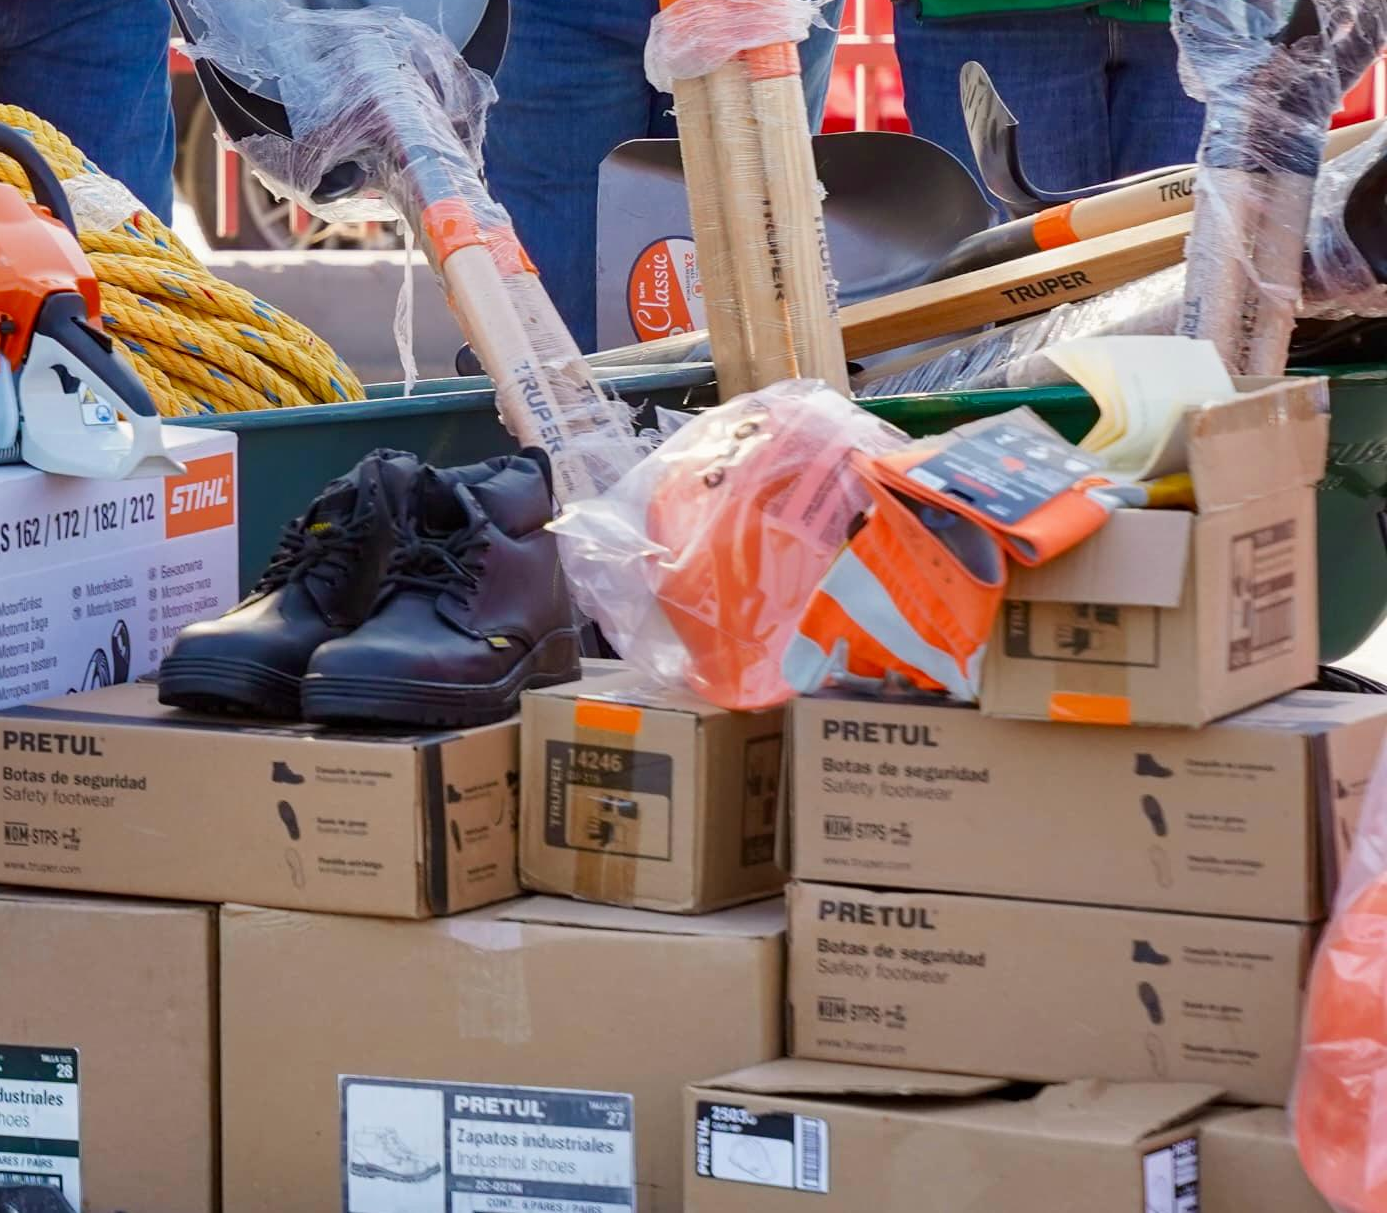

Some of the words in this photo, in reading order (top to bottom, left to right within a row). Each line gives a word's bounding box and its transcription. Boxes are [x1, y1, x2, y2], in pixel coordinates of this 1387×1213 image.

[636, 253, 672, 332] Classic
[1001, 270, 1092, 305] TRUPER
[170, 478, 228, 514] STIHL
[15, 518, 40, 549] 162
[44, 514, 50, 546] /
[55, 510, 79, 541] 172
[83, 506, 89, 538] /
[93, 501, 118, 532] 182
[121, 498, 127, 530] /
[130, 493, 155, 524] 212
[3, 730, 103, 756] PRETUL
[822, 719, 938, 747] PRETUL
[567, 748, 623, 772] 14246
[822, 757, 872, 774] Botas
[878, 762, 898, 776] de
[905, 765, 989, 783] seguridad
[3, 766, 45, 783] Botas
[51, 770, 69, 784] de
[74, 773, 146, 790] seguridad
[822, 777, 874, 798] Safety
[880, 782, 953, 800] footwear
[3, 786, 48, 806] Safety
[53, 790, 115, 807] footwear
[550, 757, 563, 827] TRUPER
[819, 900, 937, 929] PRETUL
[817, 938, 868, 956] Botas
[874, 944, 894, 958] de
[901, 948, 985, 967] seguridad
[817, 958, 869, 980] Safety
[876, 964, 949, 983] footwear
[56, 1063, 74, 1079] 28
[454, 1094, 546, 1118] PRETUL
[606, 1111, 626, 1127] 27
[457, 1128, 518, 1147] Zapatos
[523, 1131, 614, 1154] industriales
[697, 1116, 711, 1176] PRETUL
[27, 1155, 53, 1168] PAIRS
[457, 1150, 526, 1168] Industrial
[531, 1156, 577, 1174] shoes
